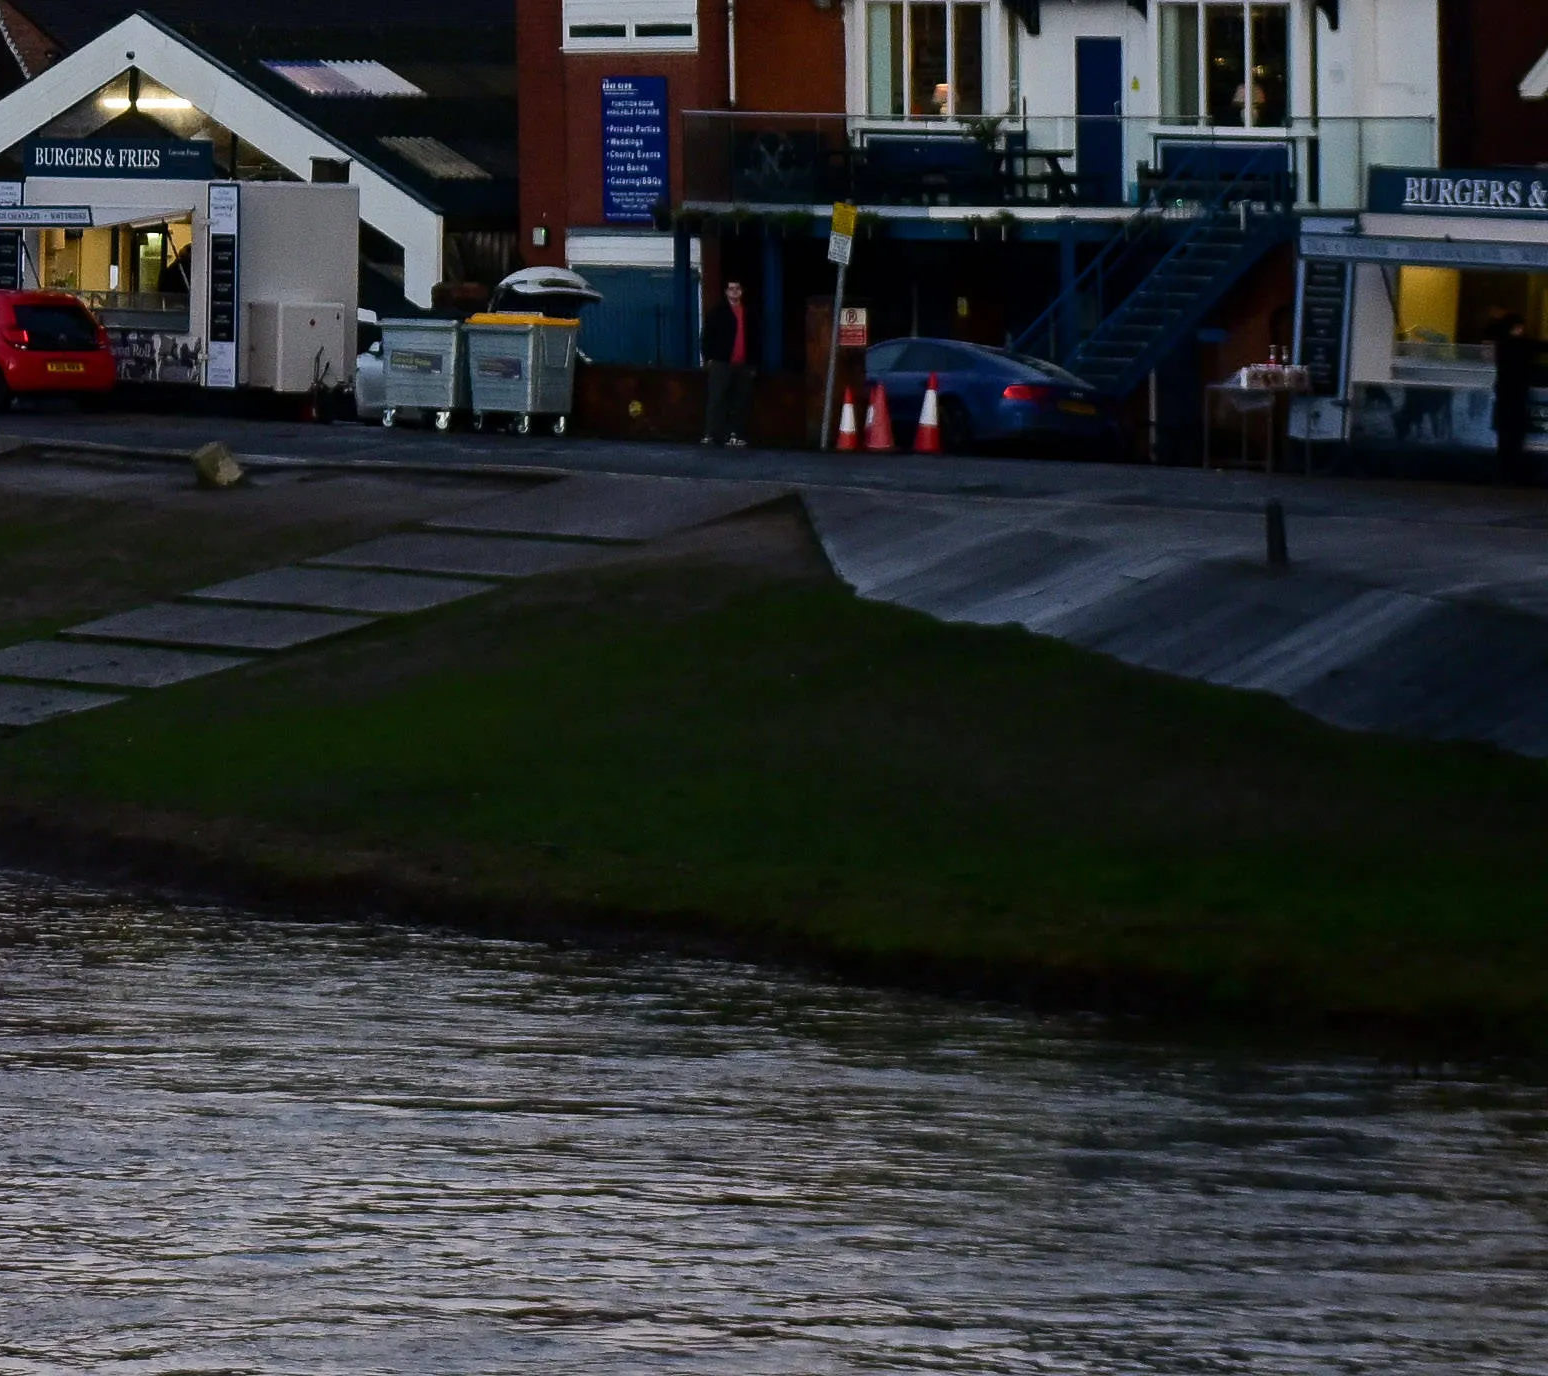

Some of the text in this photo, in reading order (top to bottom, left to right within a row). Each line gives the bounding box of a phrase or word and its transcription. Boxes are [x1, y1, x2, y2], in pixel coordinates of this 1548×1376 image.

[610, 138, 643, 147] Weddings
[34, 147, 160, 168] BURGERS & FRIES
[1404, 176, 1548, 207] BURGERS &
